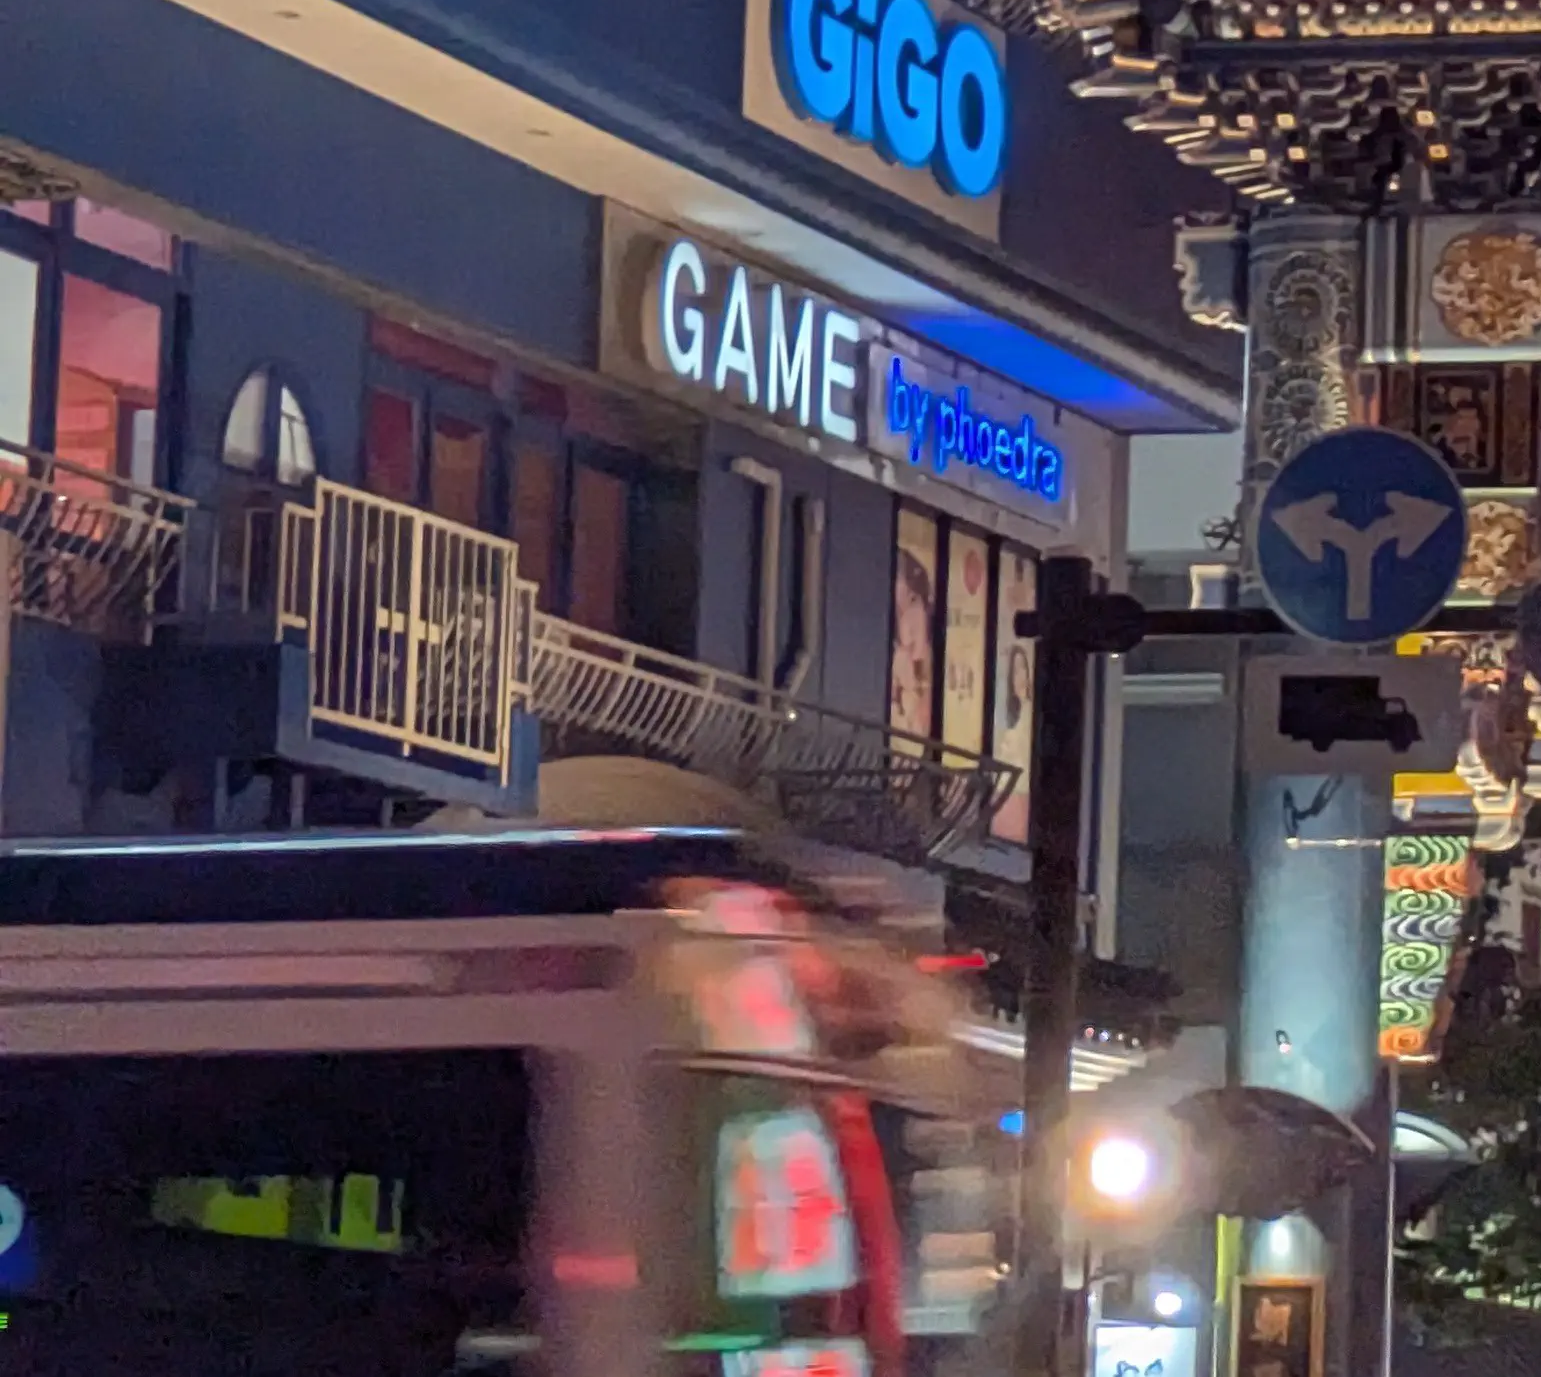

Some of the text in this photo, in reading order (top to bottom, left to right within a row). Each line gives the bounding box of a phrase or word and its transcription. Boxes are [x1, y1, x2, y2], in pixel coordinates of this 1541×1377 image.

[662, 242, 859, 443] GAME
[889, 356, 1062, 502] by phoedra
